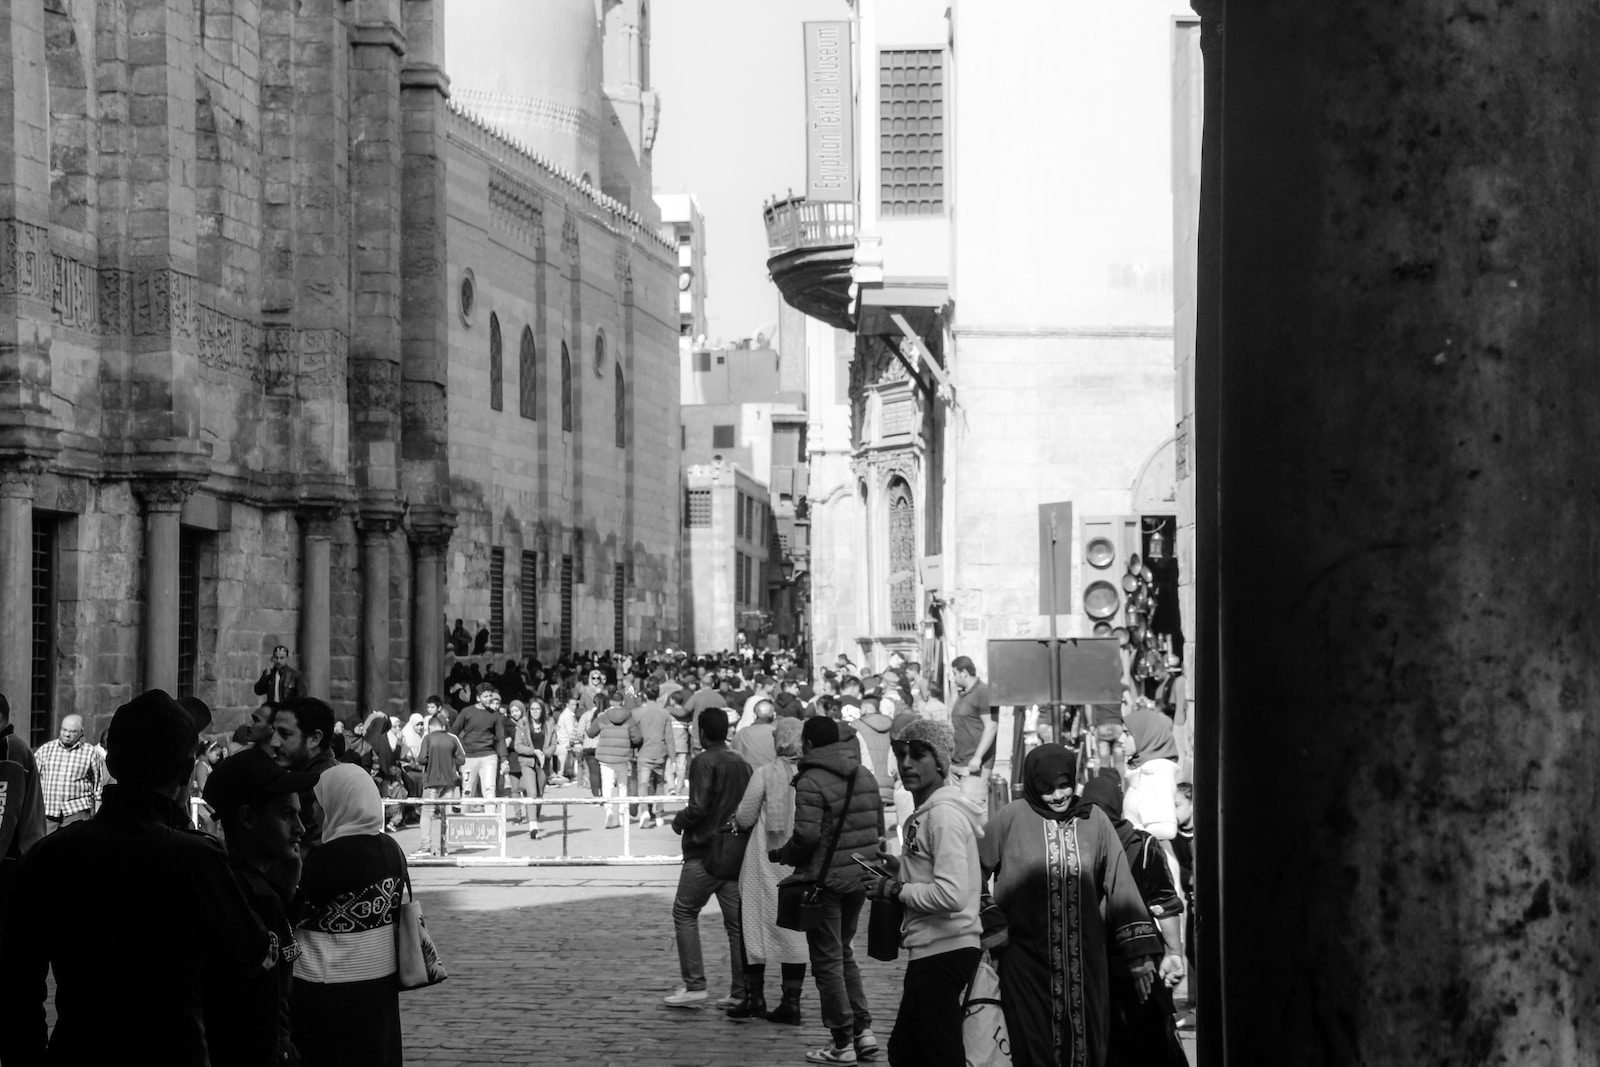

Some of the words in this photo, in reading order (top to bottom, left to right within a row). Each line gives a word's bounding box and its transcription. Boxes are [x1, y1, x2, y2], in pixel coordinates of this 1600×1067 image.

[812, 28, 840, 83] Museum
[814, 87, 840, 129] Textile
[814, 134, 848, 188] Egyptian
[450, 822, 475, 840] القاهرة
[475, 823, 497, 840] مرور
